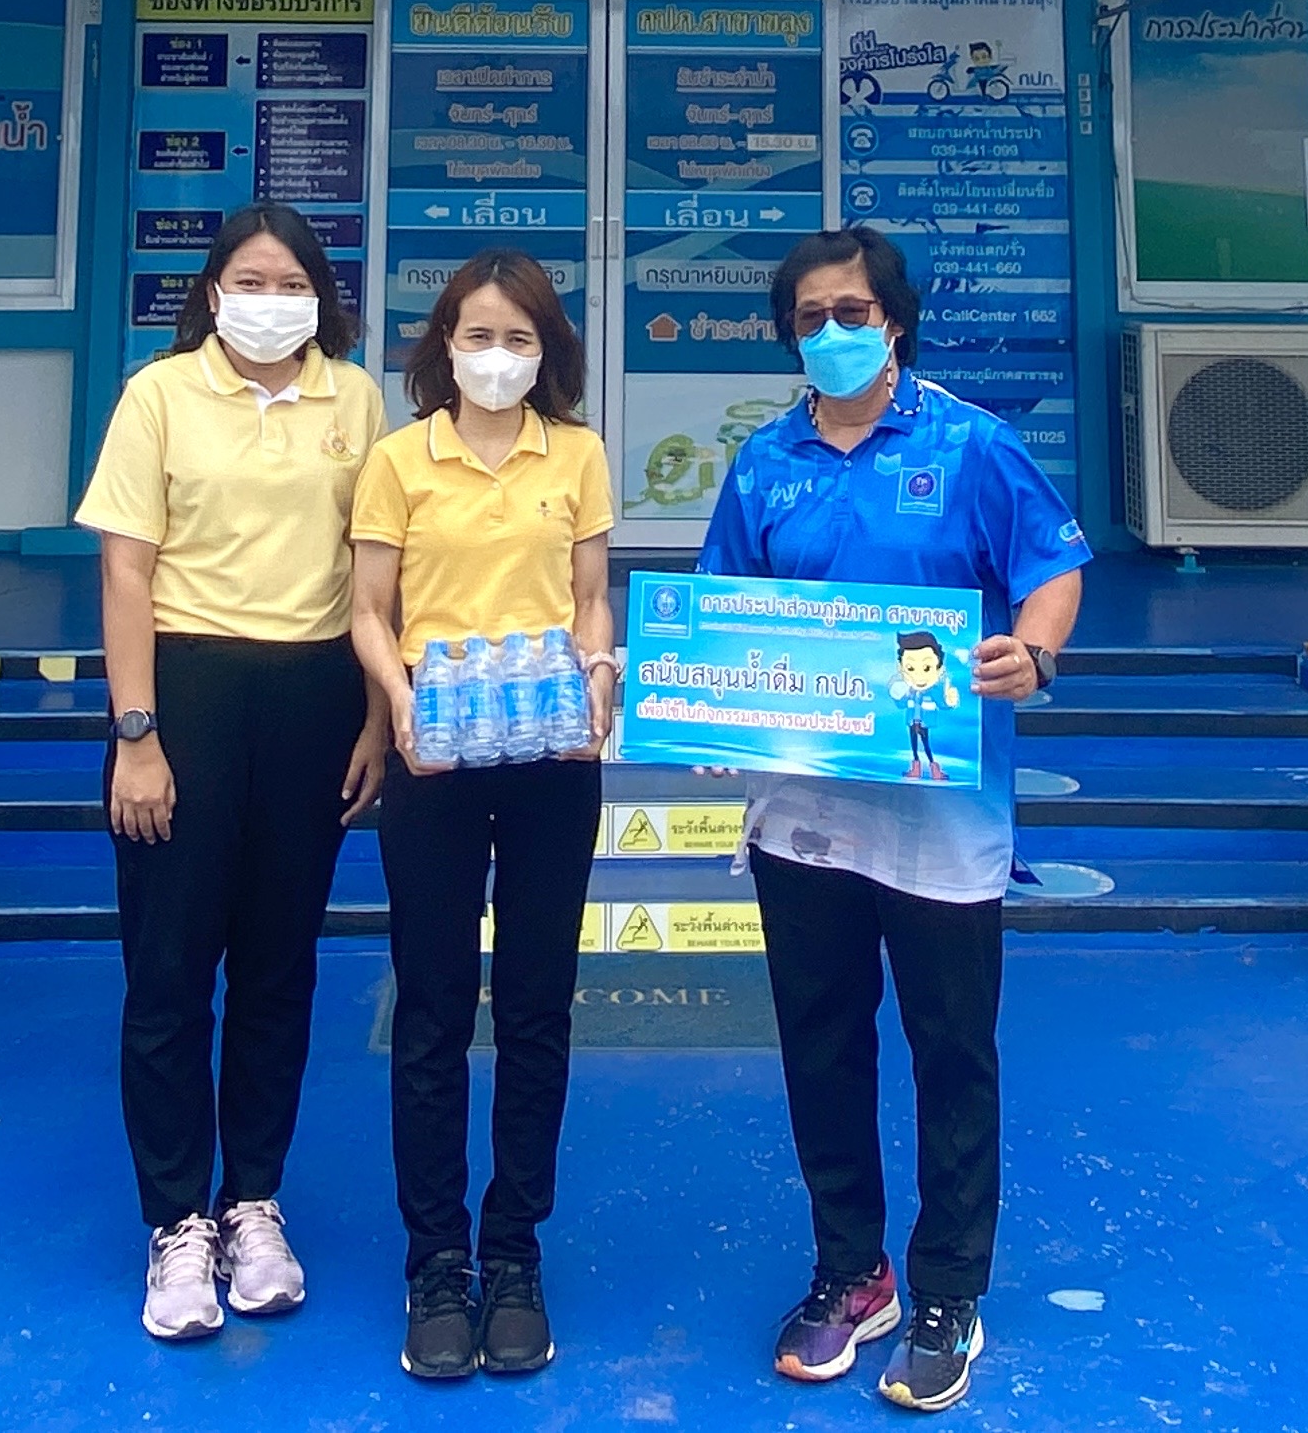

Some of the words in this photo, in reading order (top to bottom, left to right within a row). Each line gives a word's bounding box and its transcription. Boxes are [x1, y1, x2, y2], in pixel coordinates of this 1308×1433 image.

[409, 3, 574, 38] ยินดีต้อนรับ
[461, 191, 546, 226] เลื่อน
[664, 194, 749, 227] เลื่อน
[699, 592, 882, 627] การประปาส่วนภูมิภาค
[886, 606, 968, 636] สาขาขลุง
[639, 651, 805, 700] สนับสนุนน้ำดื่ม
[814, 670, 875, 701] กปภ.
